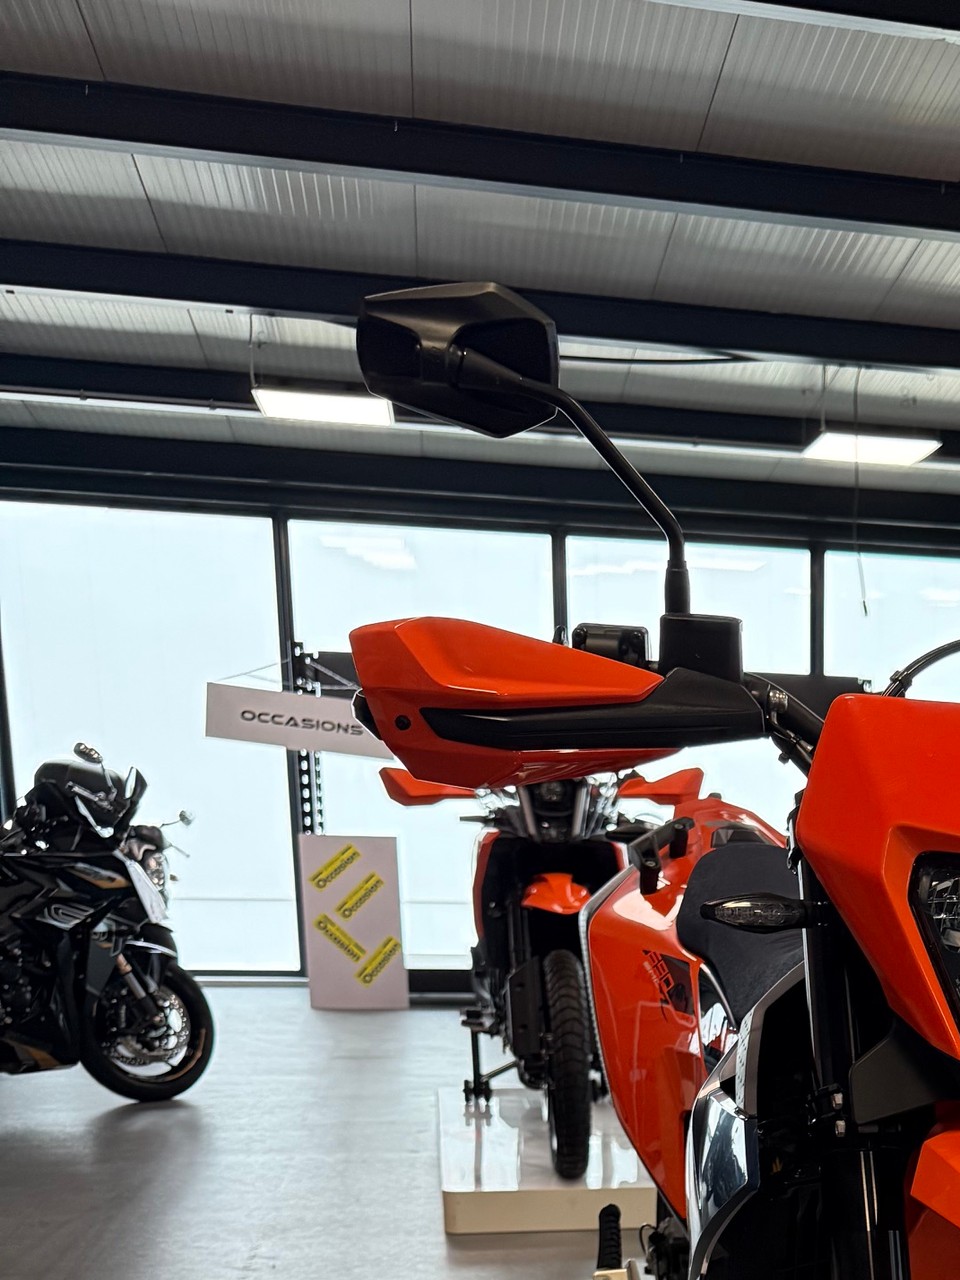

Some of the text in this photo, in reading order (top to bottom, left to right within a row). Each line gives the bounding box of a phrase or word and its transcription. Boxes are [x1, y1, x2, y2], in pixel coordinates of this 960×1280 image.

[240, 709, 364, 736] OCCASIONS
[316, 851, 358, 889] Occasion
[342, 879, 382, 918] Occasion
[317, 920, 361, 962] Occasion
[362, 943, 400, 984] Occasion
